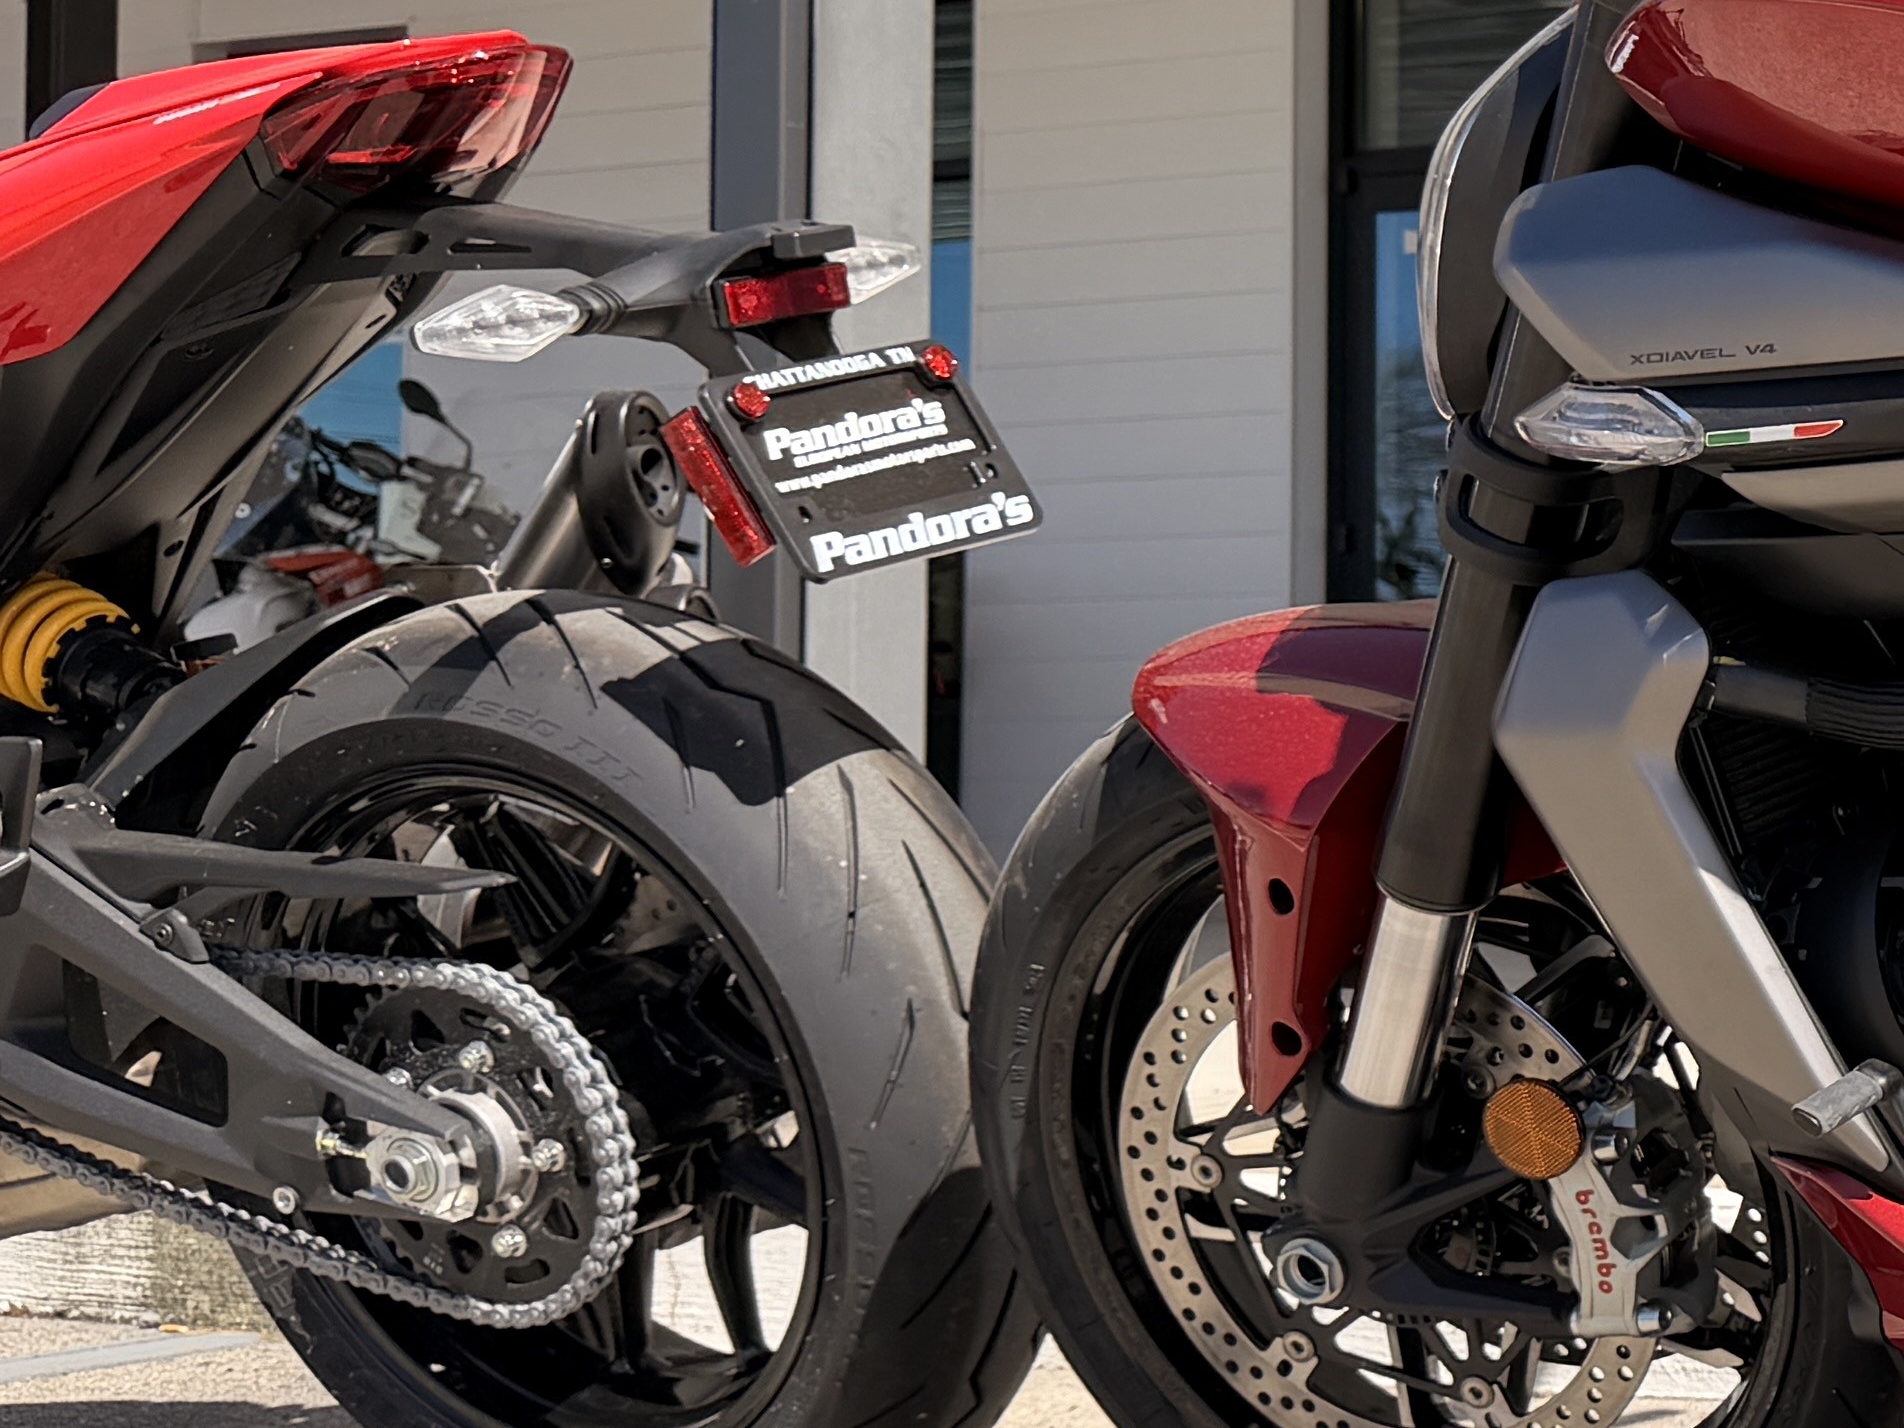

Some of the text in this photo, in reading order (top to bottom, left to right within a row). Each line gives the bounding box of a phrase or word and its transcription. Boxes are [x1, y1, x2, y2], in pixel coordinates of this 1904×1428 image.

[886, 346, 916, 369] TN
[1630, 343, 1777, 365] XDIAVEL V4
[763, 398, 947, 461] Pandora's
[809, 491, 1034, 573] Pandora's
[1573, 1187, 1616, 1296] brembo
